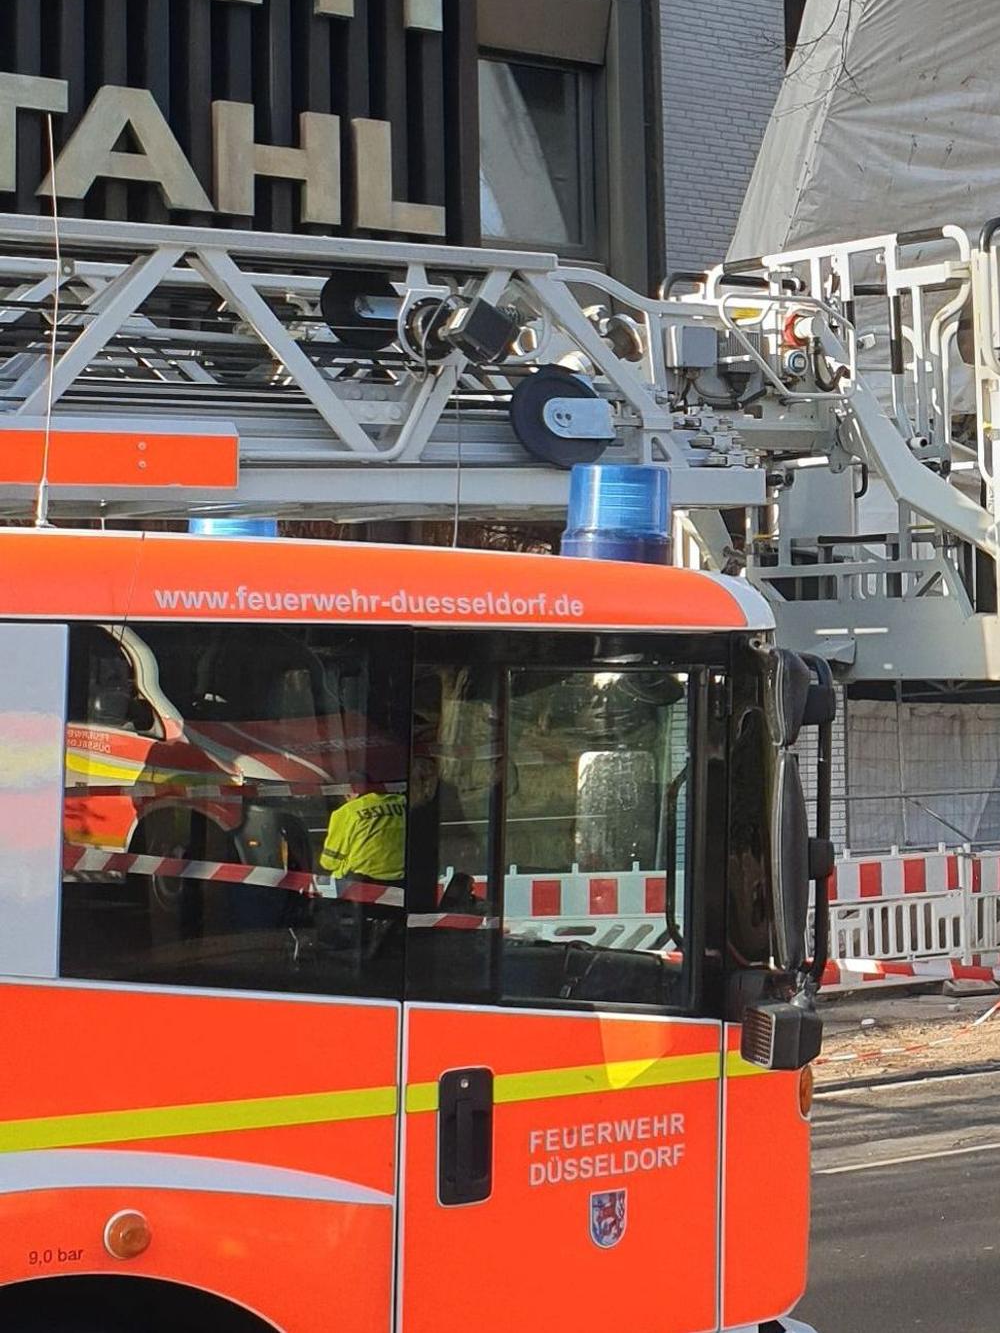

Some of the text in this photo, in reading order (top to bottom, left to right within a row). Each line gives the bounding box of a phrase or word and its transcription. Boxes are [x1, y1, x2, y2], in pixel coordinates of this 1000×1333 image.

[154, 585, 584, 616] www.feuerwehr-duesseldorf.de
[529, 1113, 685, 1153] FEUERWEHR
[529, 1143, 686, 1187] DÜSSELDORF
[29, 1248, 83, 1266] 9,0 bar
